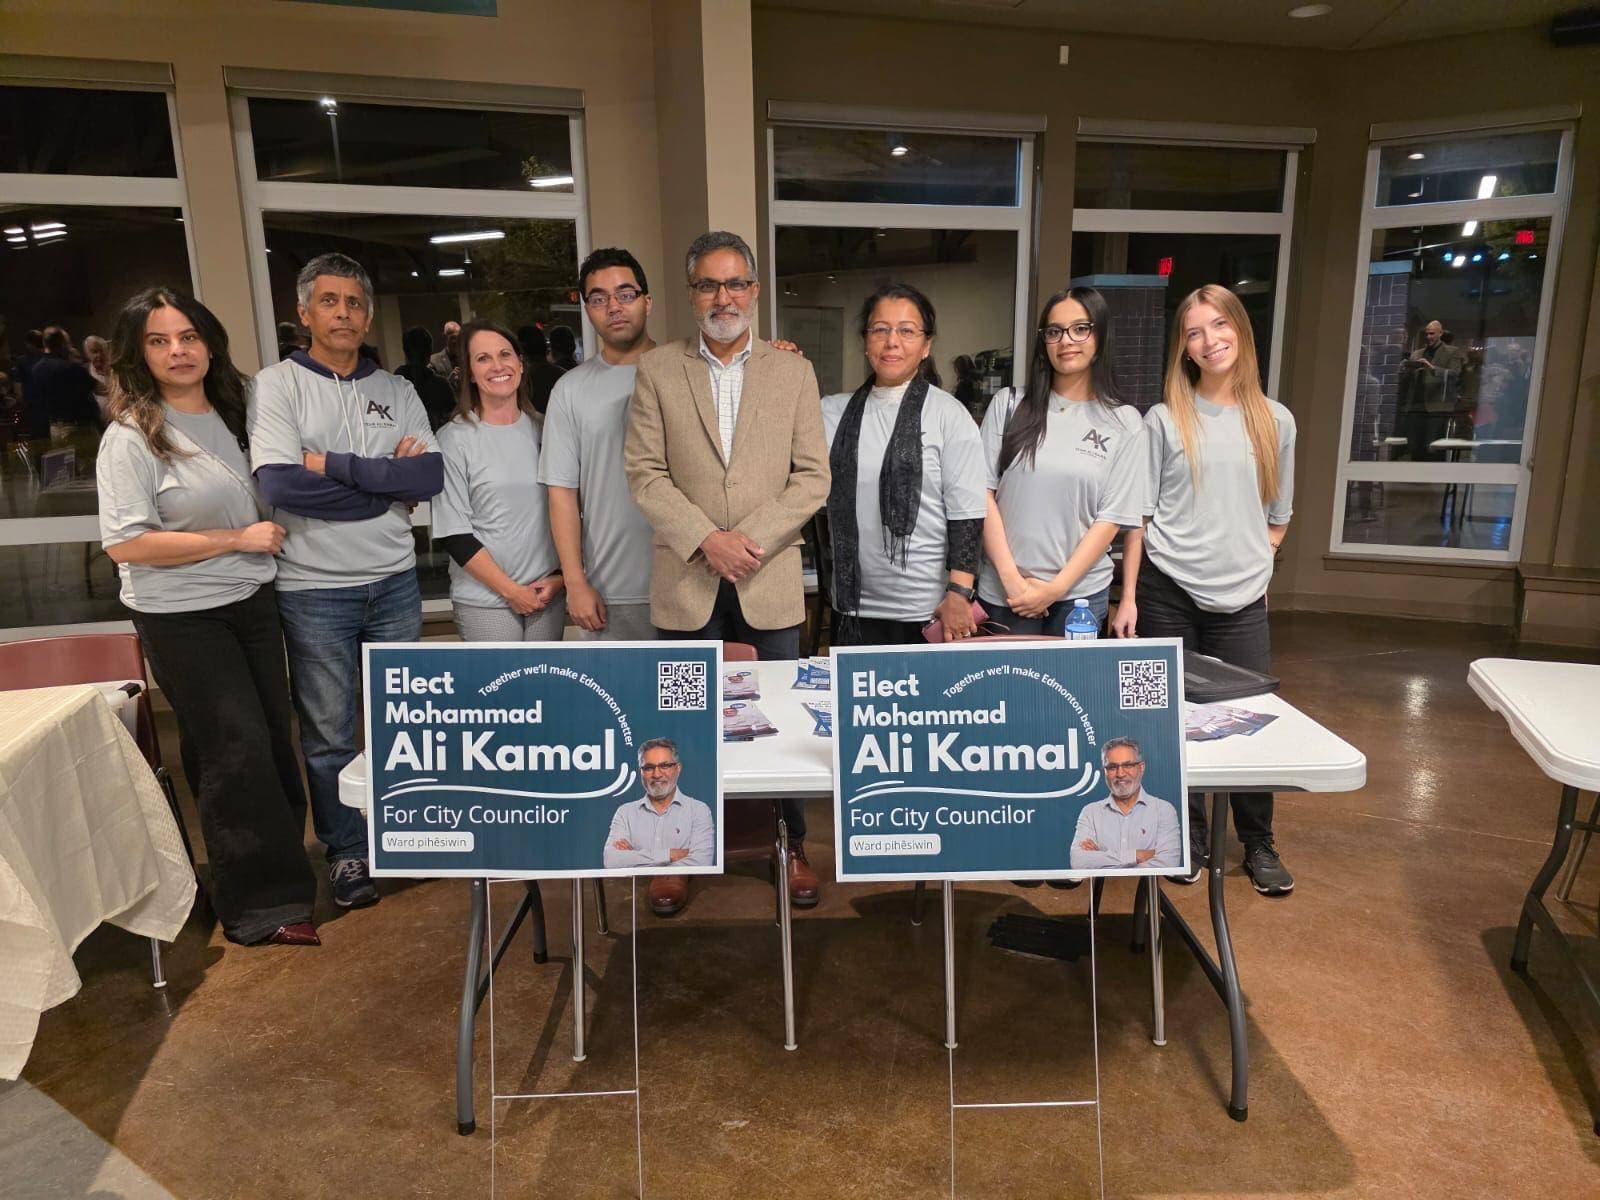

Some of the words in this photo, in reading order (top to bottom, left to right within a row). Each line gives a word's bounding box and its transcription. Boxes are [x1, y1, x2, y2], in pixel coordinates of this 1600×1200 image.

[385, 667, 454, 695] Elect
[852, 670, 920, 698] Elect
[385, 700, 542, 724] Mohammad
[478, 668, 522, 697] Together
[523, 663, 547, 674] we'll
[550, 666, 578, 680] make
[579, 673, 621, 716] Edmonton
[617, 714, 634, 748] better
[852, 701, 1006, 727] Mohammad
[942, 670, 985, 698] Together
[986, 664, 1010, 676] we'll
[1012, 666, 1041, 680] make
[1041, 673, 1084, 715] Edmonton
[1080, 713, 1097, 747] better
[384, 730, 447, 771] Ali
[462, 728, 615, 771] Kamal
[851, 732, 913, 774] Ali
[928, 728, 1079, 772] Kamal
[383, 805, 417, 824] For
[423, 804, 463, 829] City
[469, 804, 570, 824] Councilor
[850, 808, 884, 827] For
[890, 807, 930, 831] City
[935, 805, 1035, 825] Councilor
[387, 837, 415, 847] Ward
[854, 840, 882, 851] Ward
